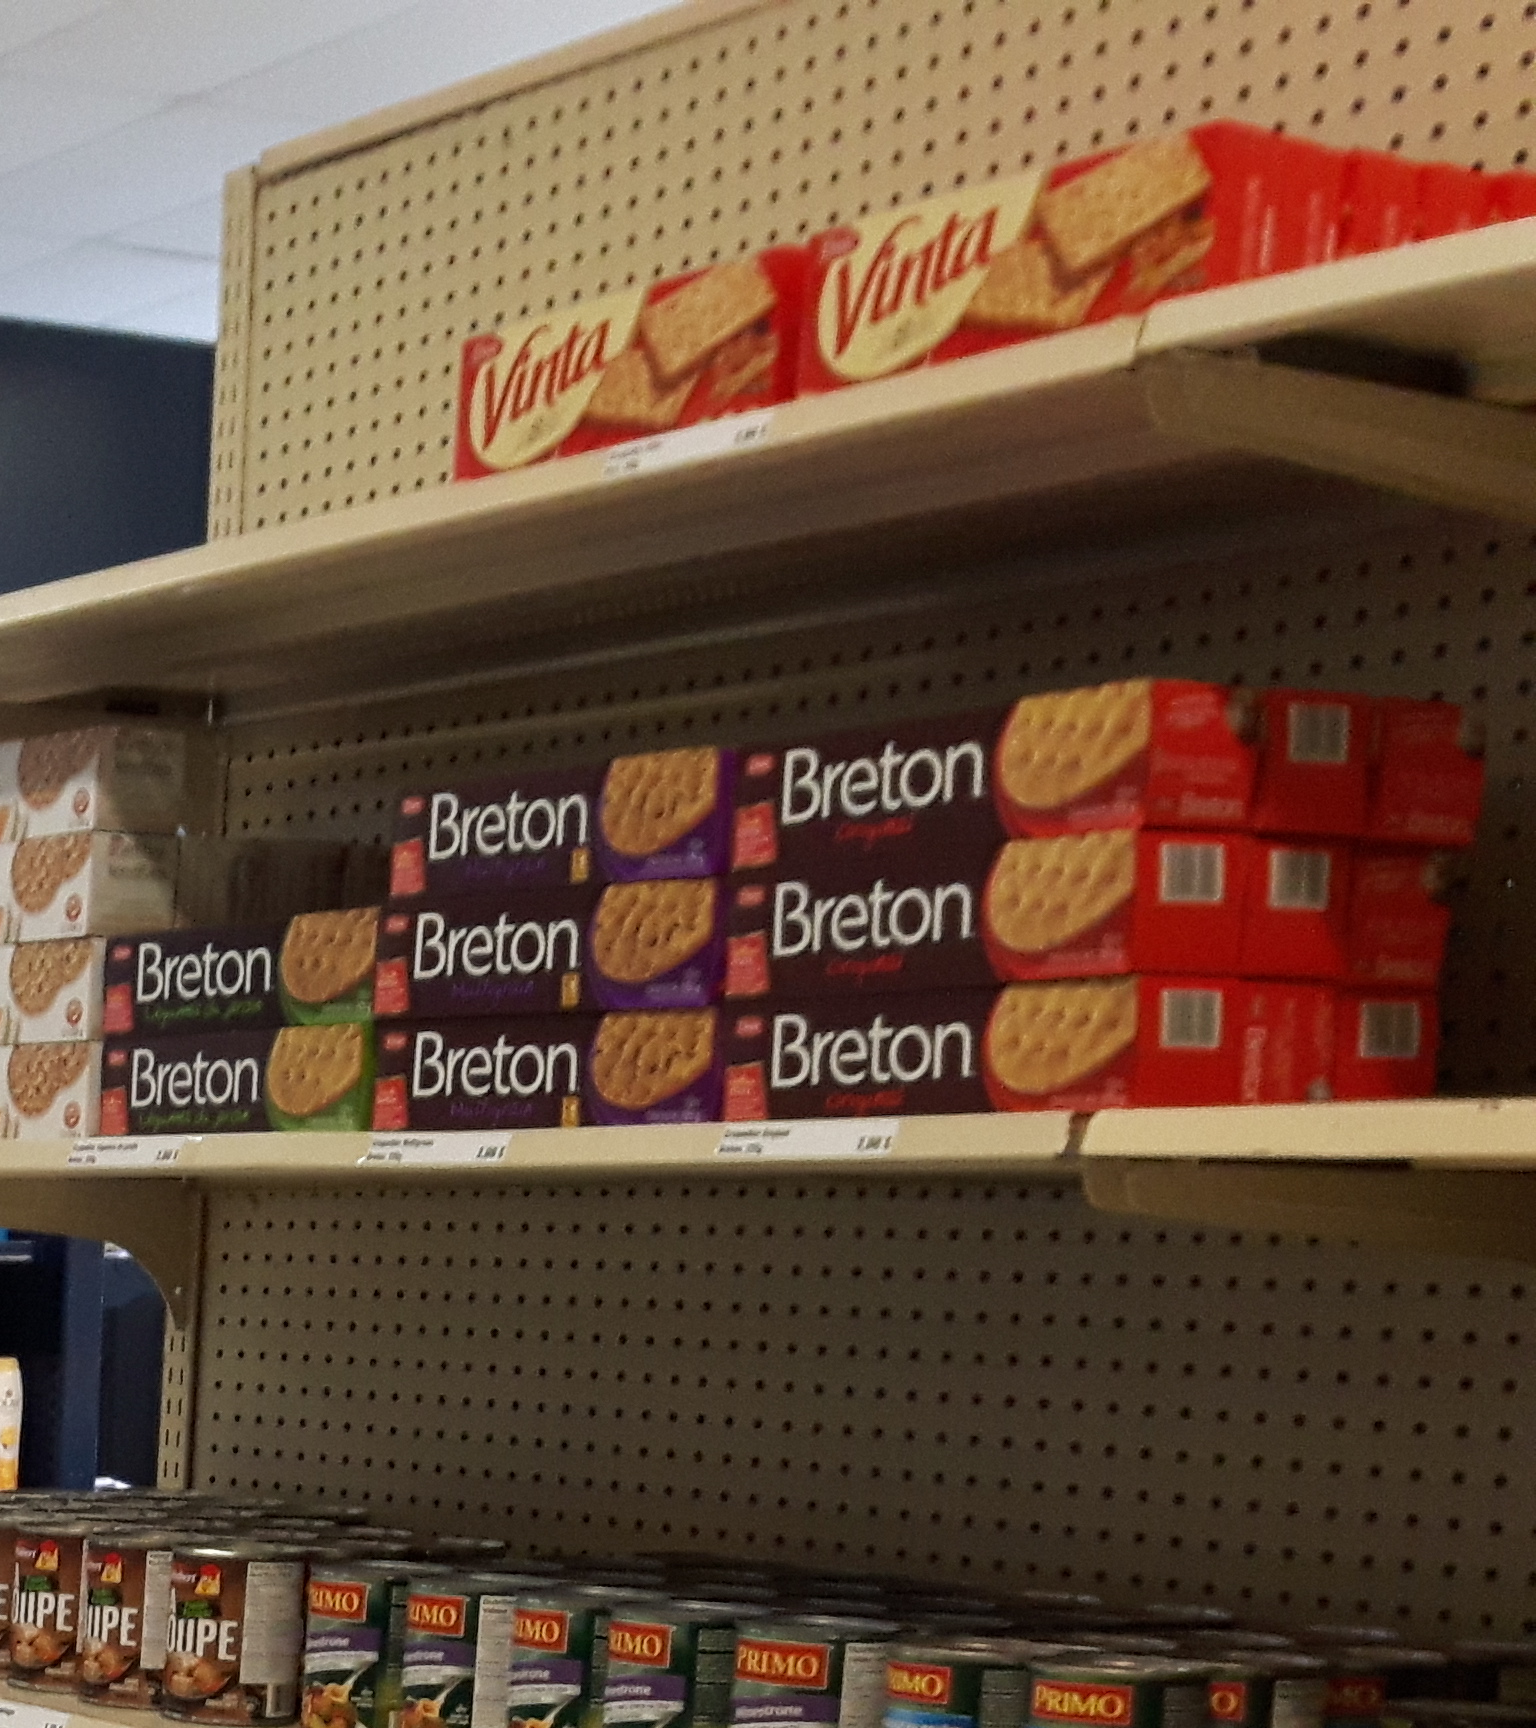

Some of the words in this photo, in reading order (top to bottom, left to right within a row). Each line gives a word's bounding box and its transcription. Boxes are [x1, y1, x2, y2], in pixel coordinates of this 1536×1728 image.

[833, 205, 1000, 360] Vinta
[482, 318, 612, 452] Vinta
[781, 740, 986, 827] Breton
[428, 789, 590, 862] Breton
[413, 911, 581, 980] Breton
[772, 877, 975, 959] Breton
[136, 942, 272, 1003] Breton
[130, 1047, 260, 1108] Breton
[411, 1030, 579, 1099] Breton
[771, 1012, 975, 1089] Breton
[11, 1591, 75, 1633] OUPE
[167, 1613, 239, 1661] OUPE
[737, 1646, 819, 1678] PRIMO
[1036, 1685, 1125, 1719] PRIMO
